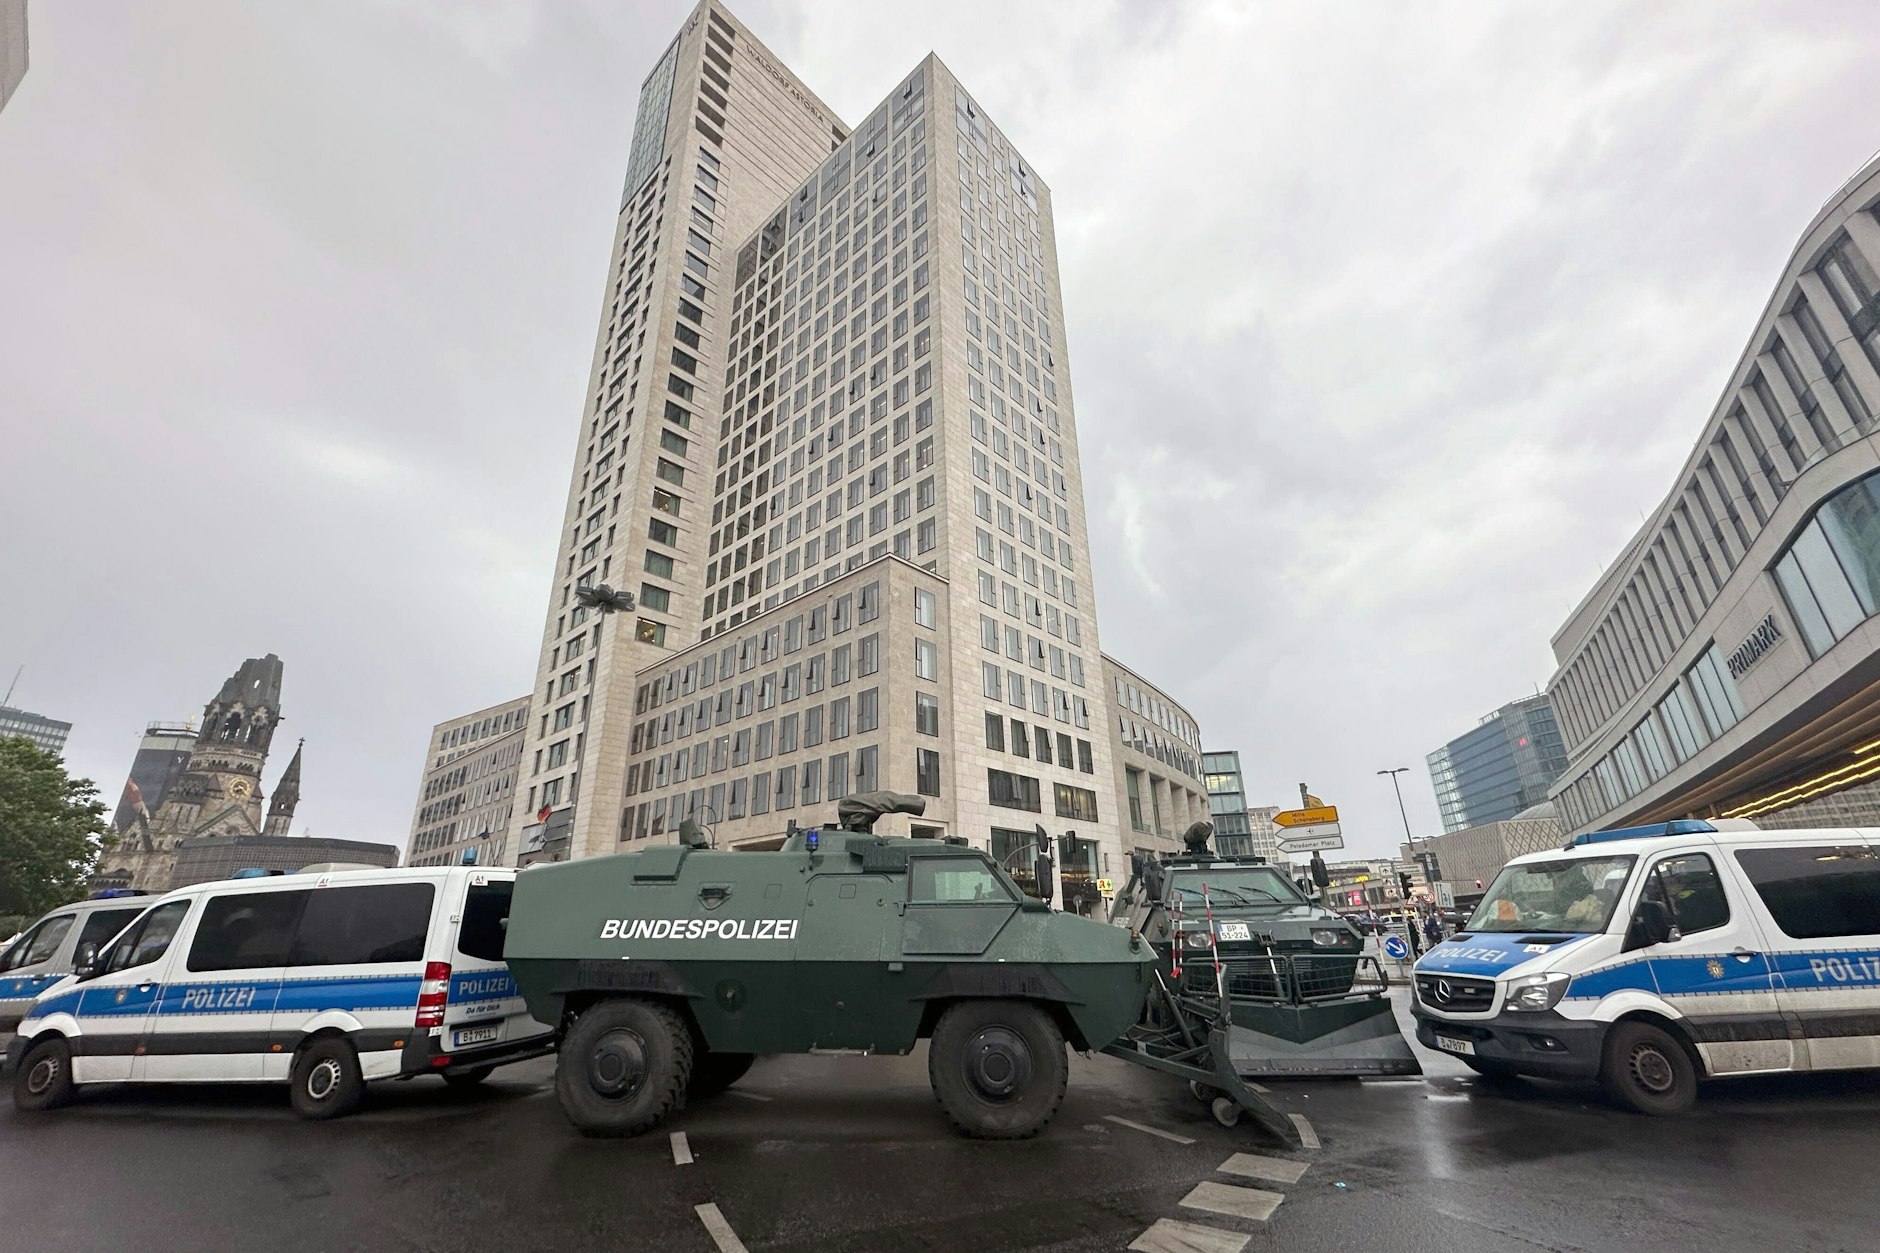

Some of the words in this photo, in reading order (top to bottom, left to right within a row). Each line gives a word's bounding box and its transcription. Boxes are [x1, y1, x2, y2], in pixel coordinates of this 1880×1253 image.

[746, 44, 790, 88] WALDORF
[790, 89, 824, 123] ASTORIA
[1727, 614, 1782, 680] PRIMARK
[599, 919, 799, 940] BUNDESPOLIZEI
[1430, 947, 1508, 963] POLIZEI
[459, 977, 509, 995] POLIZEI
[181, 986, 257, 1009] POLIZEI
[463, 1032, 469, 1042] B
[474, 1029, 492, 1038] 7911
